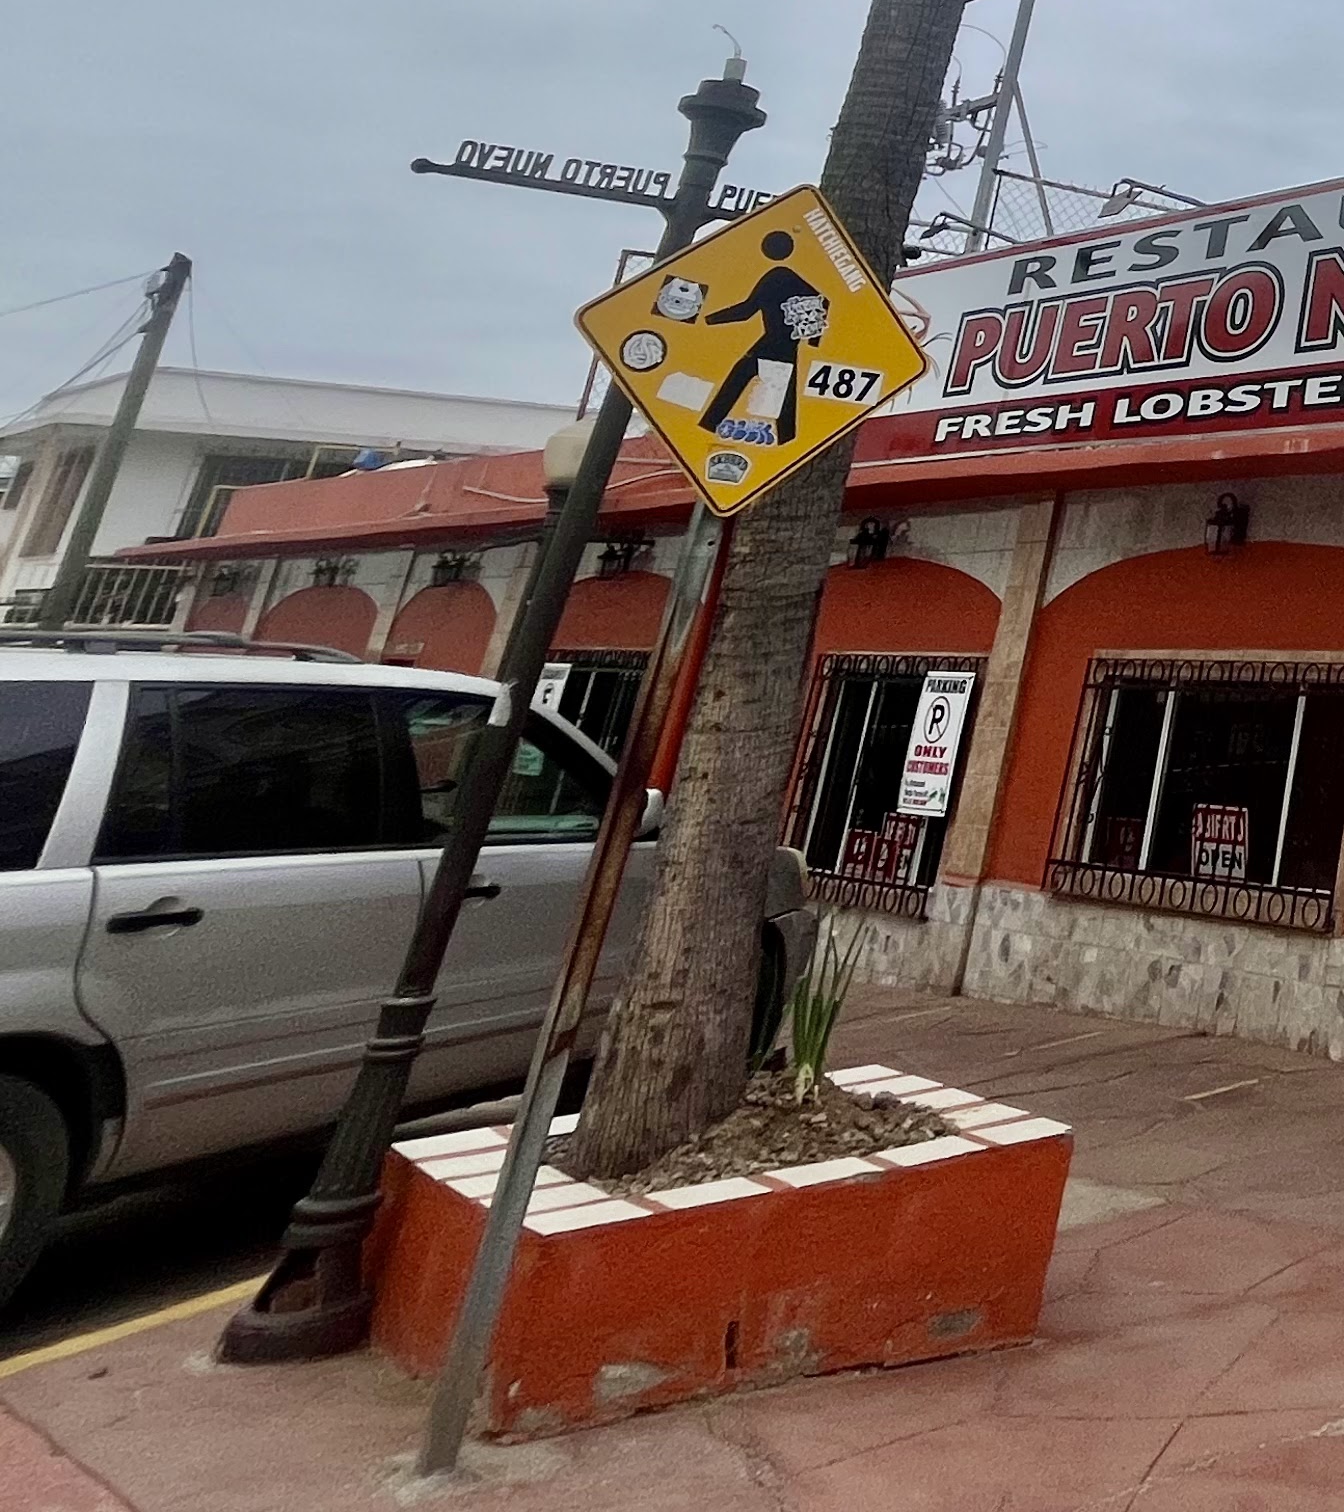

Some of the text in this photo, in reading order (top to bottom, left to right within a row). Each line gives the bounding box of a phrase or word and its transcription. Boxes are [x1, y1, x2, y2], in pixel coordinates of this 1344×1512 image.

[719, 184, 777, 214] PUE
[943, 261, 1285, 398] PUERTO
[807, 365, 881, 403] 487
[934, 403, 1096, 442] FRESH
[924, 679, 968, 694] PARKING
[914, 745, 947, 759] ONLY
